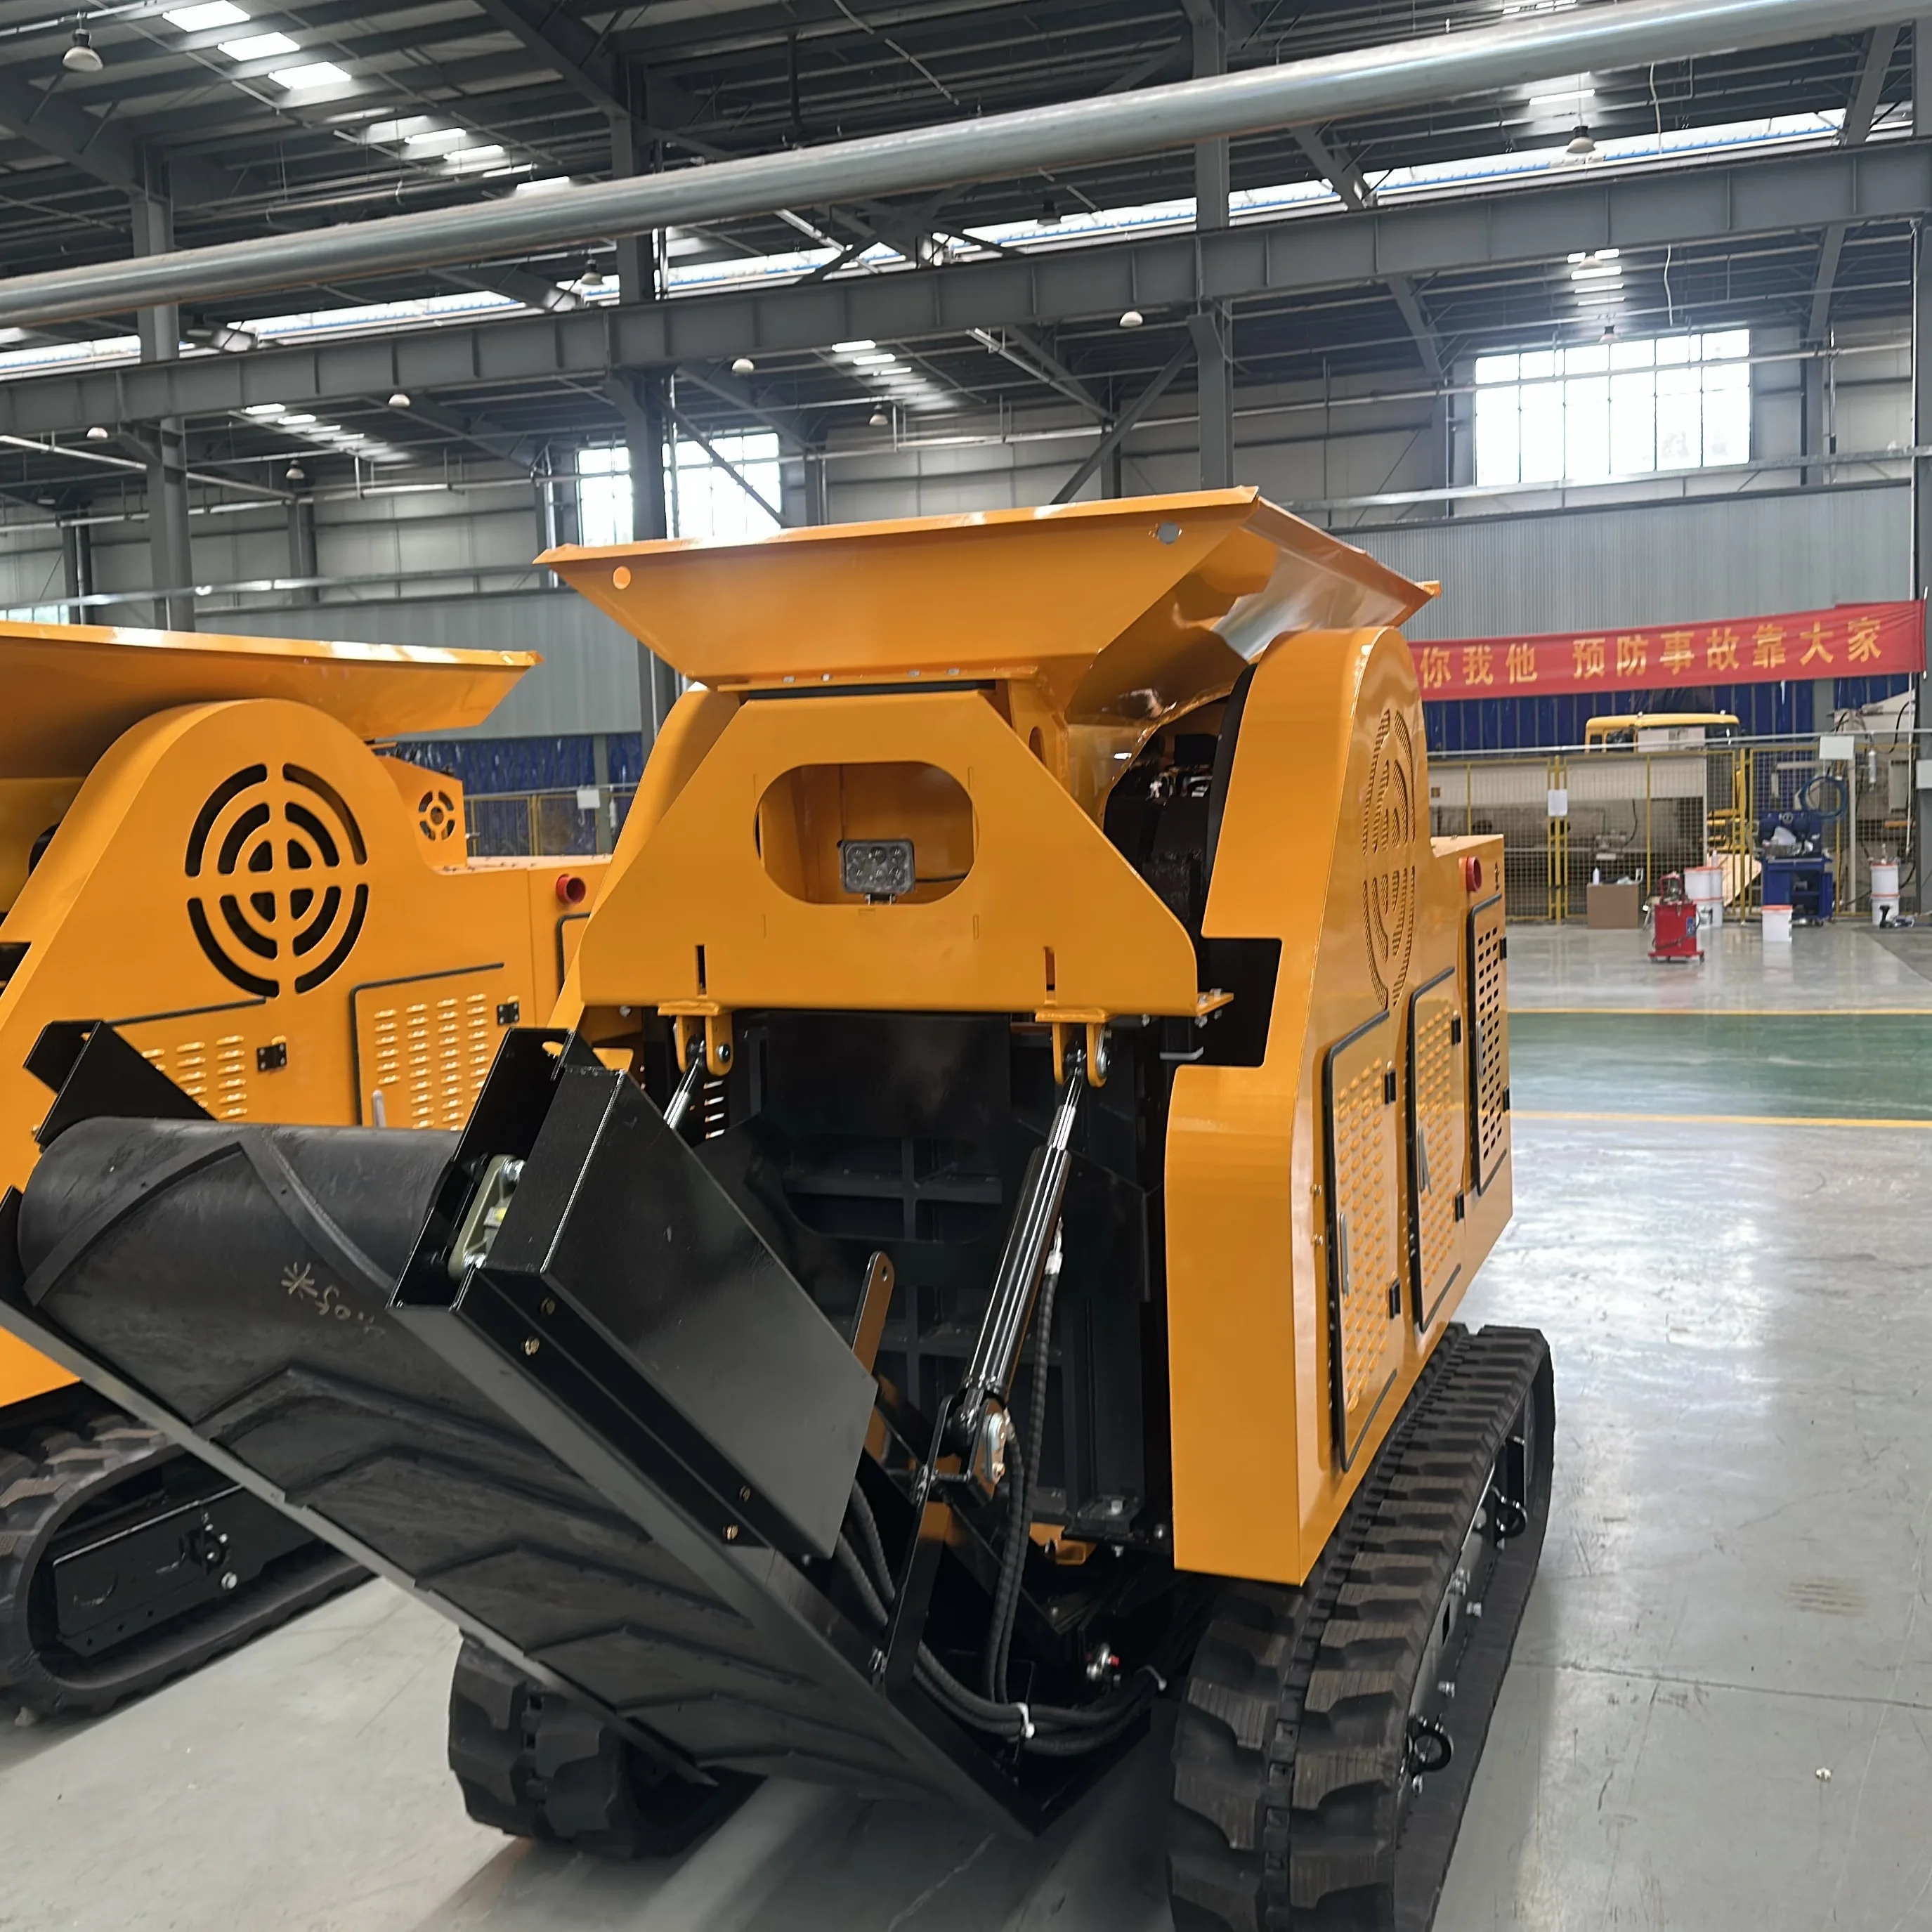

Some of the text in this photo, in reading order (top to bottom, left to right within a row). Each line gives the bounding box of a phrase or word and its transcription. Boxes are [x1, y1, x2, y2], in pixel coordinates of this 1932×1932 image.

[1420, 617, 1882, 688] 你我他 预防事故靠大家
